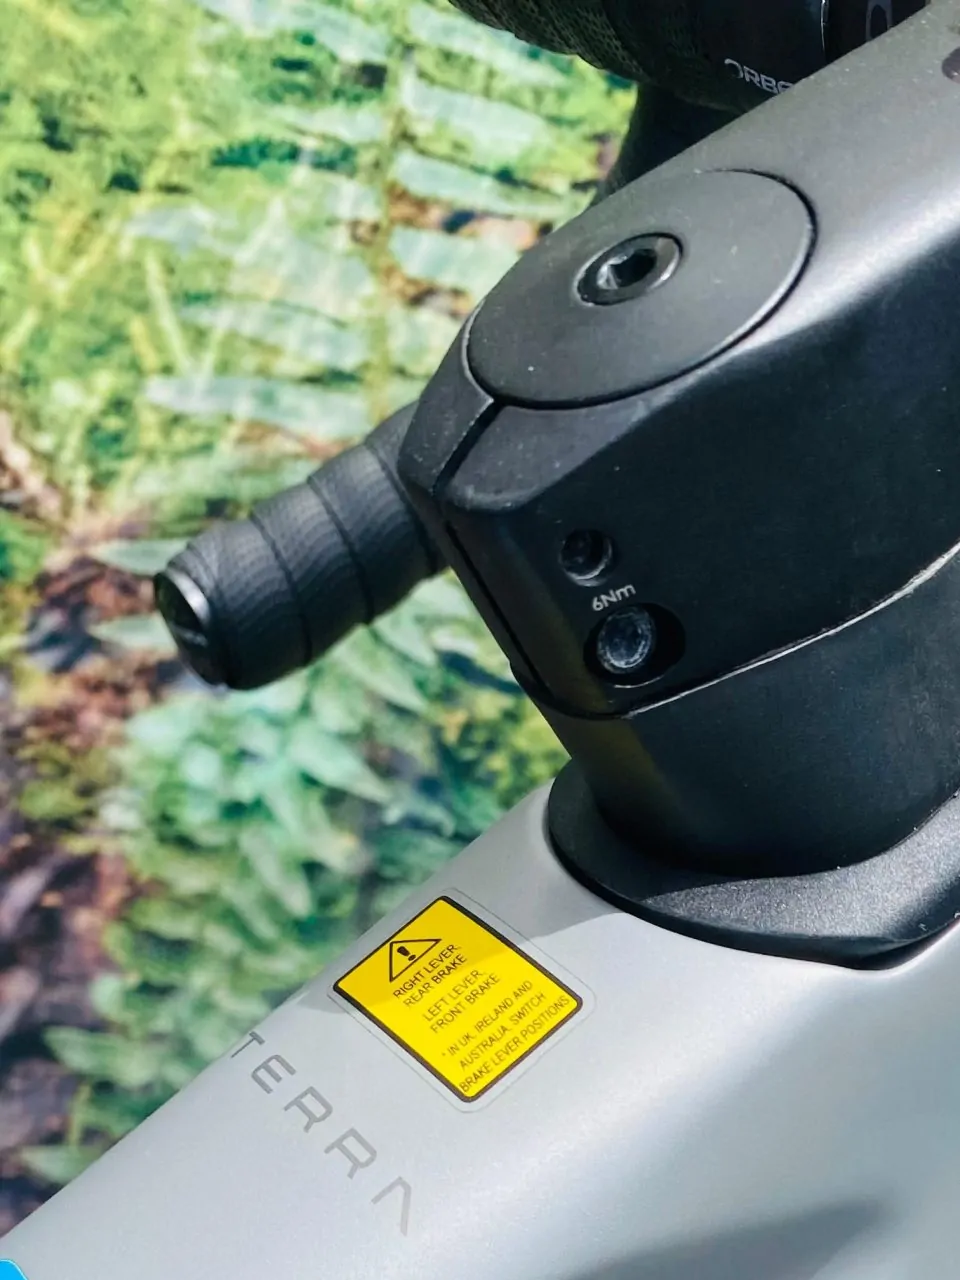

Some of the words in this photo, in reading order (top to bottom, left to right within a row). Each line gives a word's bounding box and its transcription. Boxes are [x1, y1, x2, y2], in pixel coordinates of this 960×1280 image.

[591, 584, 637, 611] 6Nm
[393, 971, 425, 998] RIGHT
[403, 982, 435, 1007] REAR
[431, 953, 467, 984] BRAKE
[430, 1001, 466, 1033] FRONT
[464, 973, 500, 1005] BRAKE
[422, 997, 450, 1022] LEFT
[447, 1045, 459, 1056] IN
[474, 997, 514, 1033] IRELAND
[512, 980, 533, 1000] AND
[508, 992, 547, 1026] SWITCH
[459, 1061, 492, 1093] BRAKE
[490, 1036, 524, 1067] LEVER
[520, 994, 570, 1040] POSITIONS
[231, 1031, 412, 1237] TERRA
